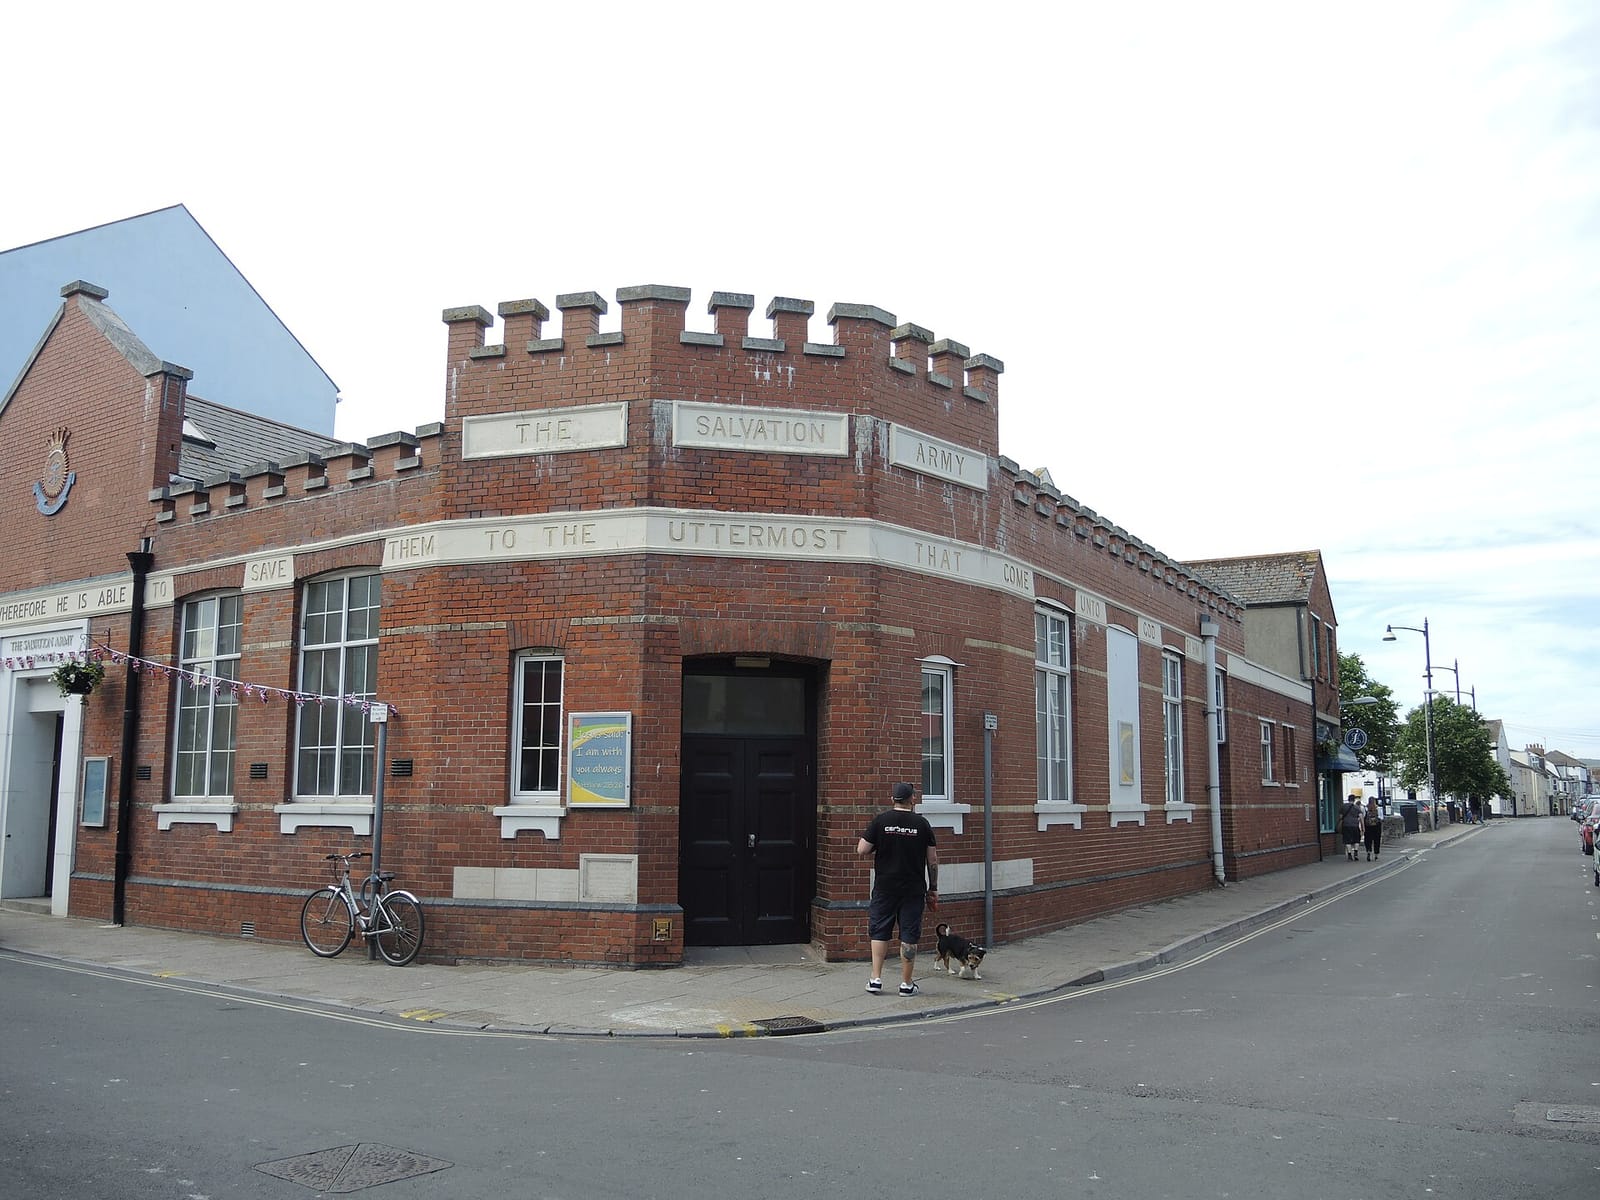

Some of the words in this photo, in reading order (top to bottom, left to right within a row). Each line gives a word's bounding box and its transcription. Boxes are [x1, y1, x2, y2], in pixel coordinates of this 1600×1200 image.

[516, 419, 572, 444] THE
[696, 415, 825, 444] SALVATION
[916, 442, 965, 476] ARMY
[0, 599, 47, 622] HEREFORE
[56, 596, 69, 613] HE
[78, 593, 87, 609] IS
[97, 586, 127, 607] ABLE
[152, 581, 167, 599] TO
[250, 559, 287, 582] SAVE
[388, 534, 435, 561] THEM
[485, 529, 517, 551] TO
[543, 523, 596, 547] THE
[668, 521, 848, 551] UTTERMOST
[914, 541, 962, 573] THAT
[1003, 563, 1029, 591] COME
[1080, 594, 1100, 619] UNTO
[10, 640, 23, 652] THE
[23, 636, 54, 651] SALVATION
[54, 634, 74, 647] ARMY
[575, 747, 584, 757] I
[585, 749, 600, 757] am
[601, 746, 623, 757] with
[575, 765, 591, 775] you
[592, 763, 623, 775] always
